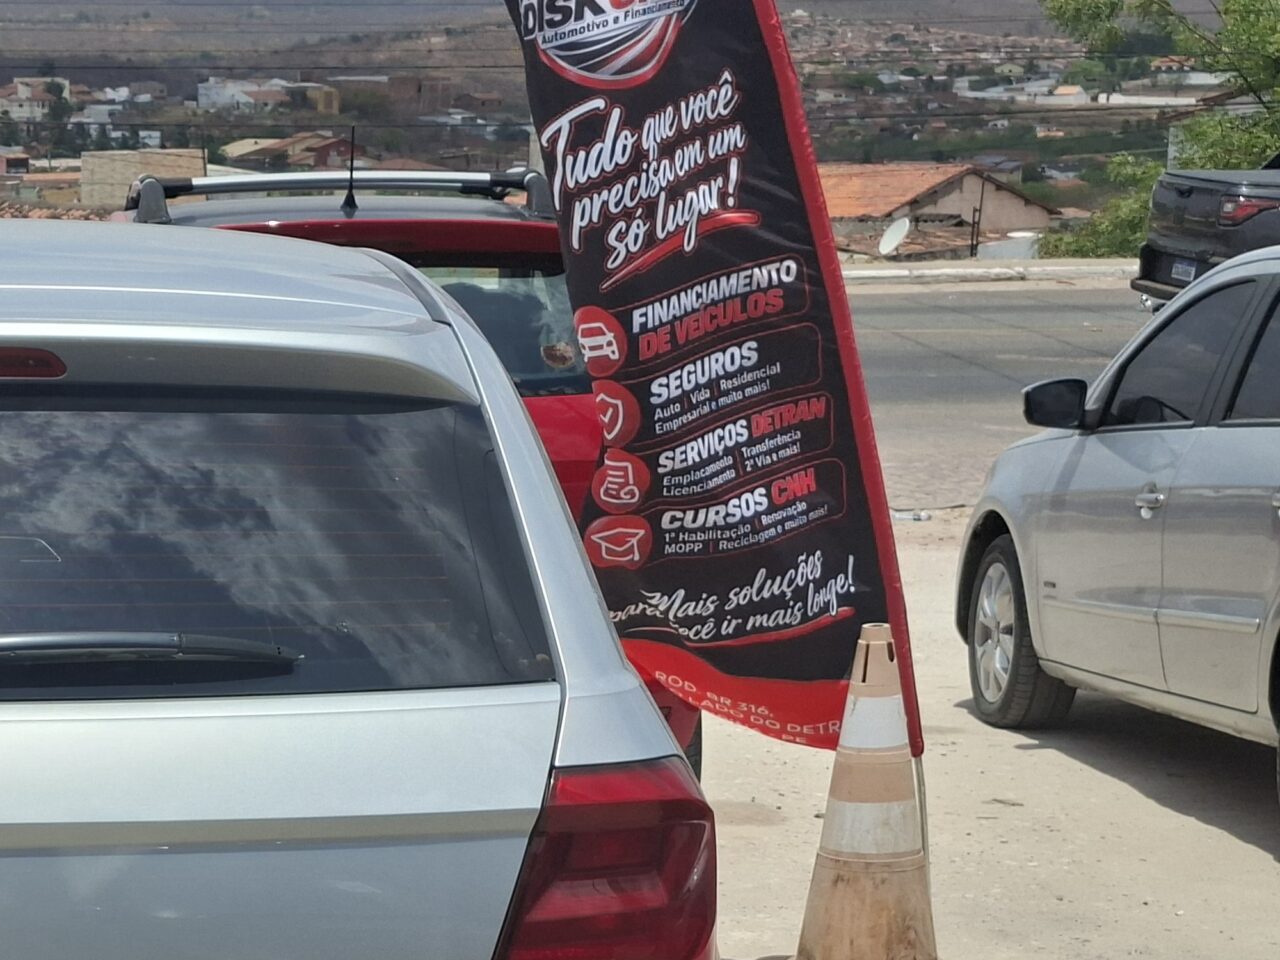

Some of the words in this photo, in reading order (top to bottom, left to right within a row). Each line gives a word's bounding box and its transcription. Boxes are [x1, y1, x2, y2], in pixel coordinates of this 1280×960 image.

[541, 19, 609, 45] Automotivo
[541, 98, 638, 210] Tudo
[642, 106, 678, 161] que
[680, 71, 738, 129] você
[572, 159, 674, 249] precisa
[675, 140, 705, 176] em
[708, 125, 745, 160] um
[607, 208, 650, 269] só
[632, 259, 797, 333] FINANCIAMENTO
[639, 325, 671, 360] DE
[674, 288, 784, 345] VEÍCULOS
[650, 341, 758, 404] SEGUROS
[654, 402, 681, 420] Auto
[690, 387, 710, 404] Vida
[720, 362, 781, 391] Residencial
[655, 401, 710, 434] Empresarial
[718, 391, 743, 407] muito
[744, 379, 771, 397] mais!
[657, 419, 749, 473] SERVIÇOS
[751, 396, 826, 438] DETRAN
[663, 455, 733, 486] Emplacamento
[741, 429, 801, 459] Transferência
[663, 468, 736, 496] Licenciamento
[756, 454, 771, 468] Via
[778, 442, 801, 460] mais!
[661, 487, 768, 530] CURSOS
[771, 467, 817, 505] CNH
[679, 524, 751, 542] Habilitação
[761, 501, 807, 526] Renovação
[664, 542, 703, 554] MOPP
[719, 527, 776, 550] Reciclagem
[640, 588, 719, 622] Mais
[725, 550, 823, 610] soluções
[672, 619, 716, 640] ocê
[721, 617, 742, 636] ir
[746, 600, 804, 628] mais
[807, 555, 855, 616] longe!
[750, 715, 780, 729] DO
[787, 720, 840, 735] DETR
